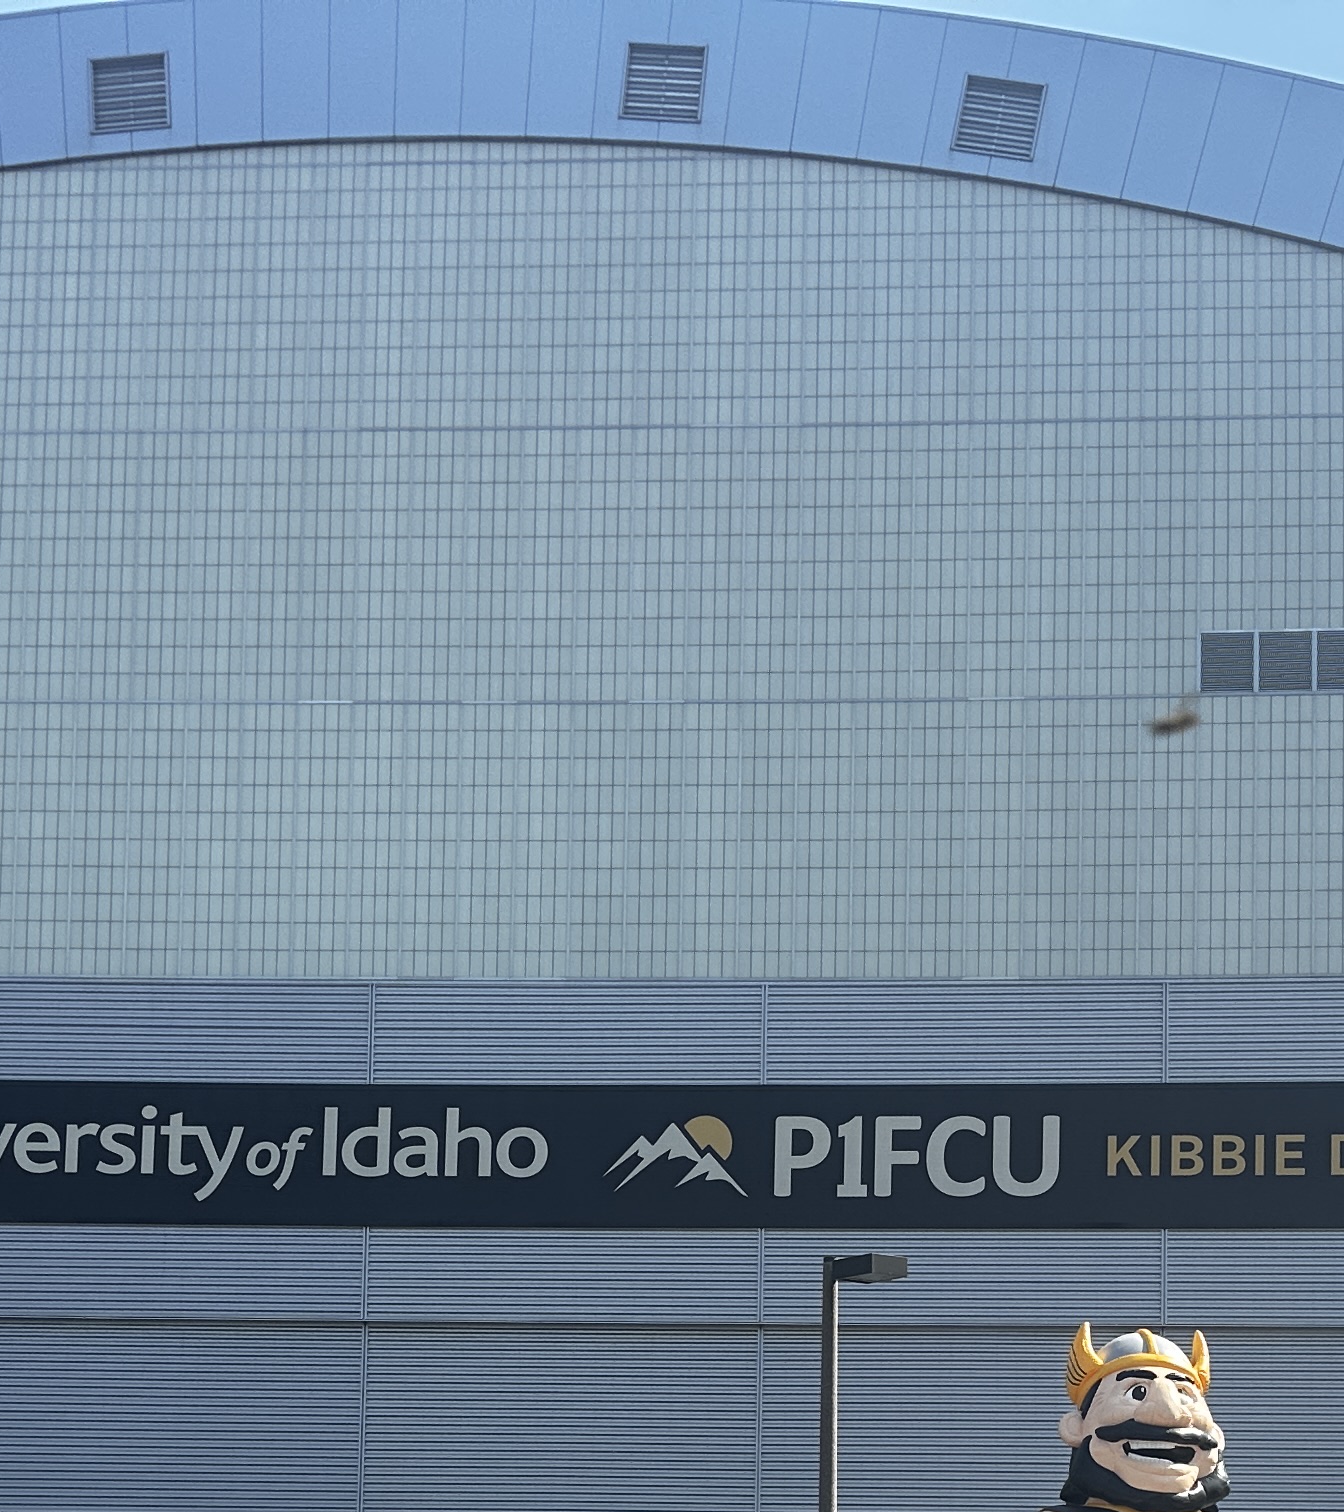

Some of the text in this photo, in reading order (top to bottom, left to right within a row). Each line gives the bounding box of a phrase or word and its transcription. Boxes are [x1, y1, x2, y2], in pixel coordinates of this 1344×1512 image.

[245, 1126, 314, 1191] of
[322, 1106, 549, 1179] Idaho
[773, 1114, 1062, 1198] P1FCU
[1105, 1132, 1308, 1178] KIBBIE
